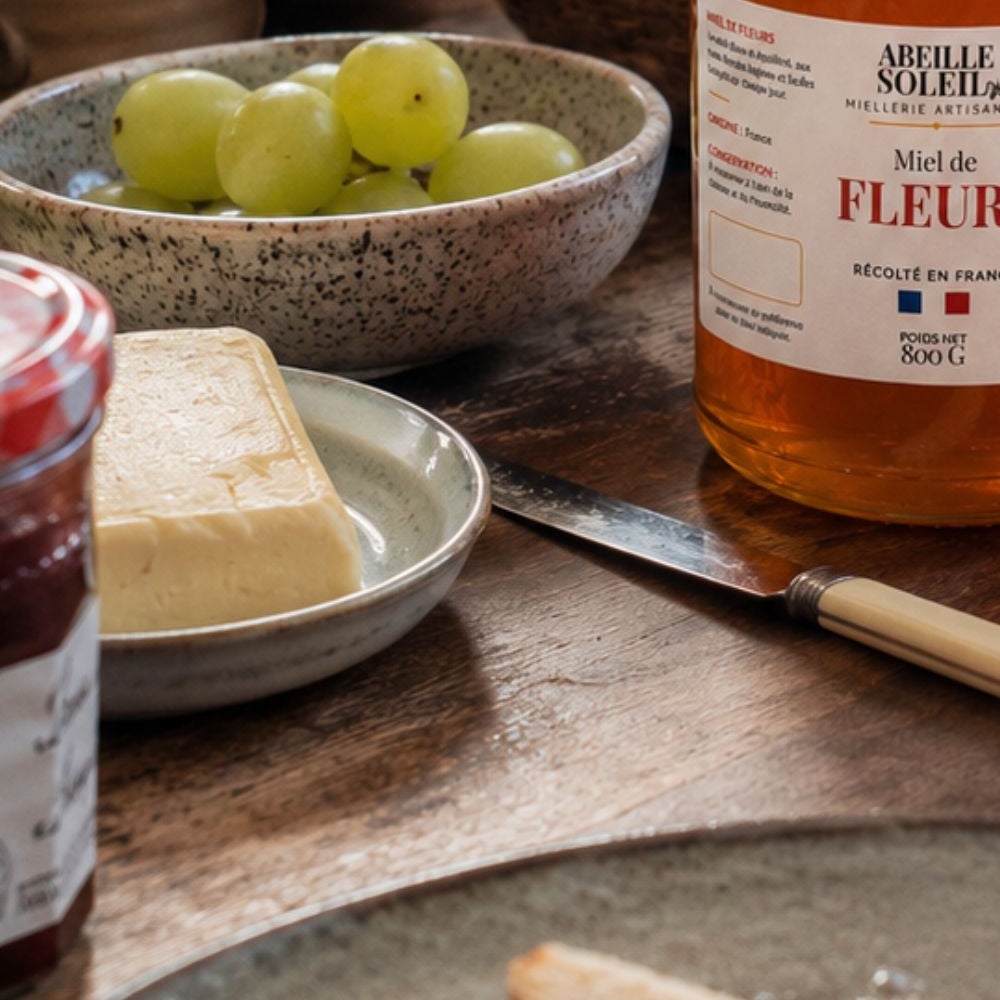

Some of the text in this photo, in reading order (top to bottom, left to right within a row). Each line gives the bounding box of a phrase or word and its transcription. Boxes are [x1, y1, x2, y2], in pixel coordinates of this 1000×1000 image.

[738, 24, 776, 44] FLEURS
[878, 43, 994, 69] ABEILLE
[877, 68, 986, 97] SOLEIL
[845, 98, 926, 115] MIELLERIE
[894, 149, 978, 173] Miel de
[853, 263, 921, 281] RÉCOLTÉ
[927, 270, 949, 282] EN
[899, 331, 967, 345] POIDS NET
[901, 343, 966, 366] 800 G
